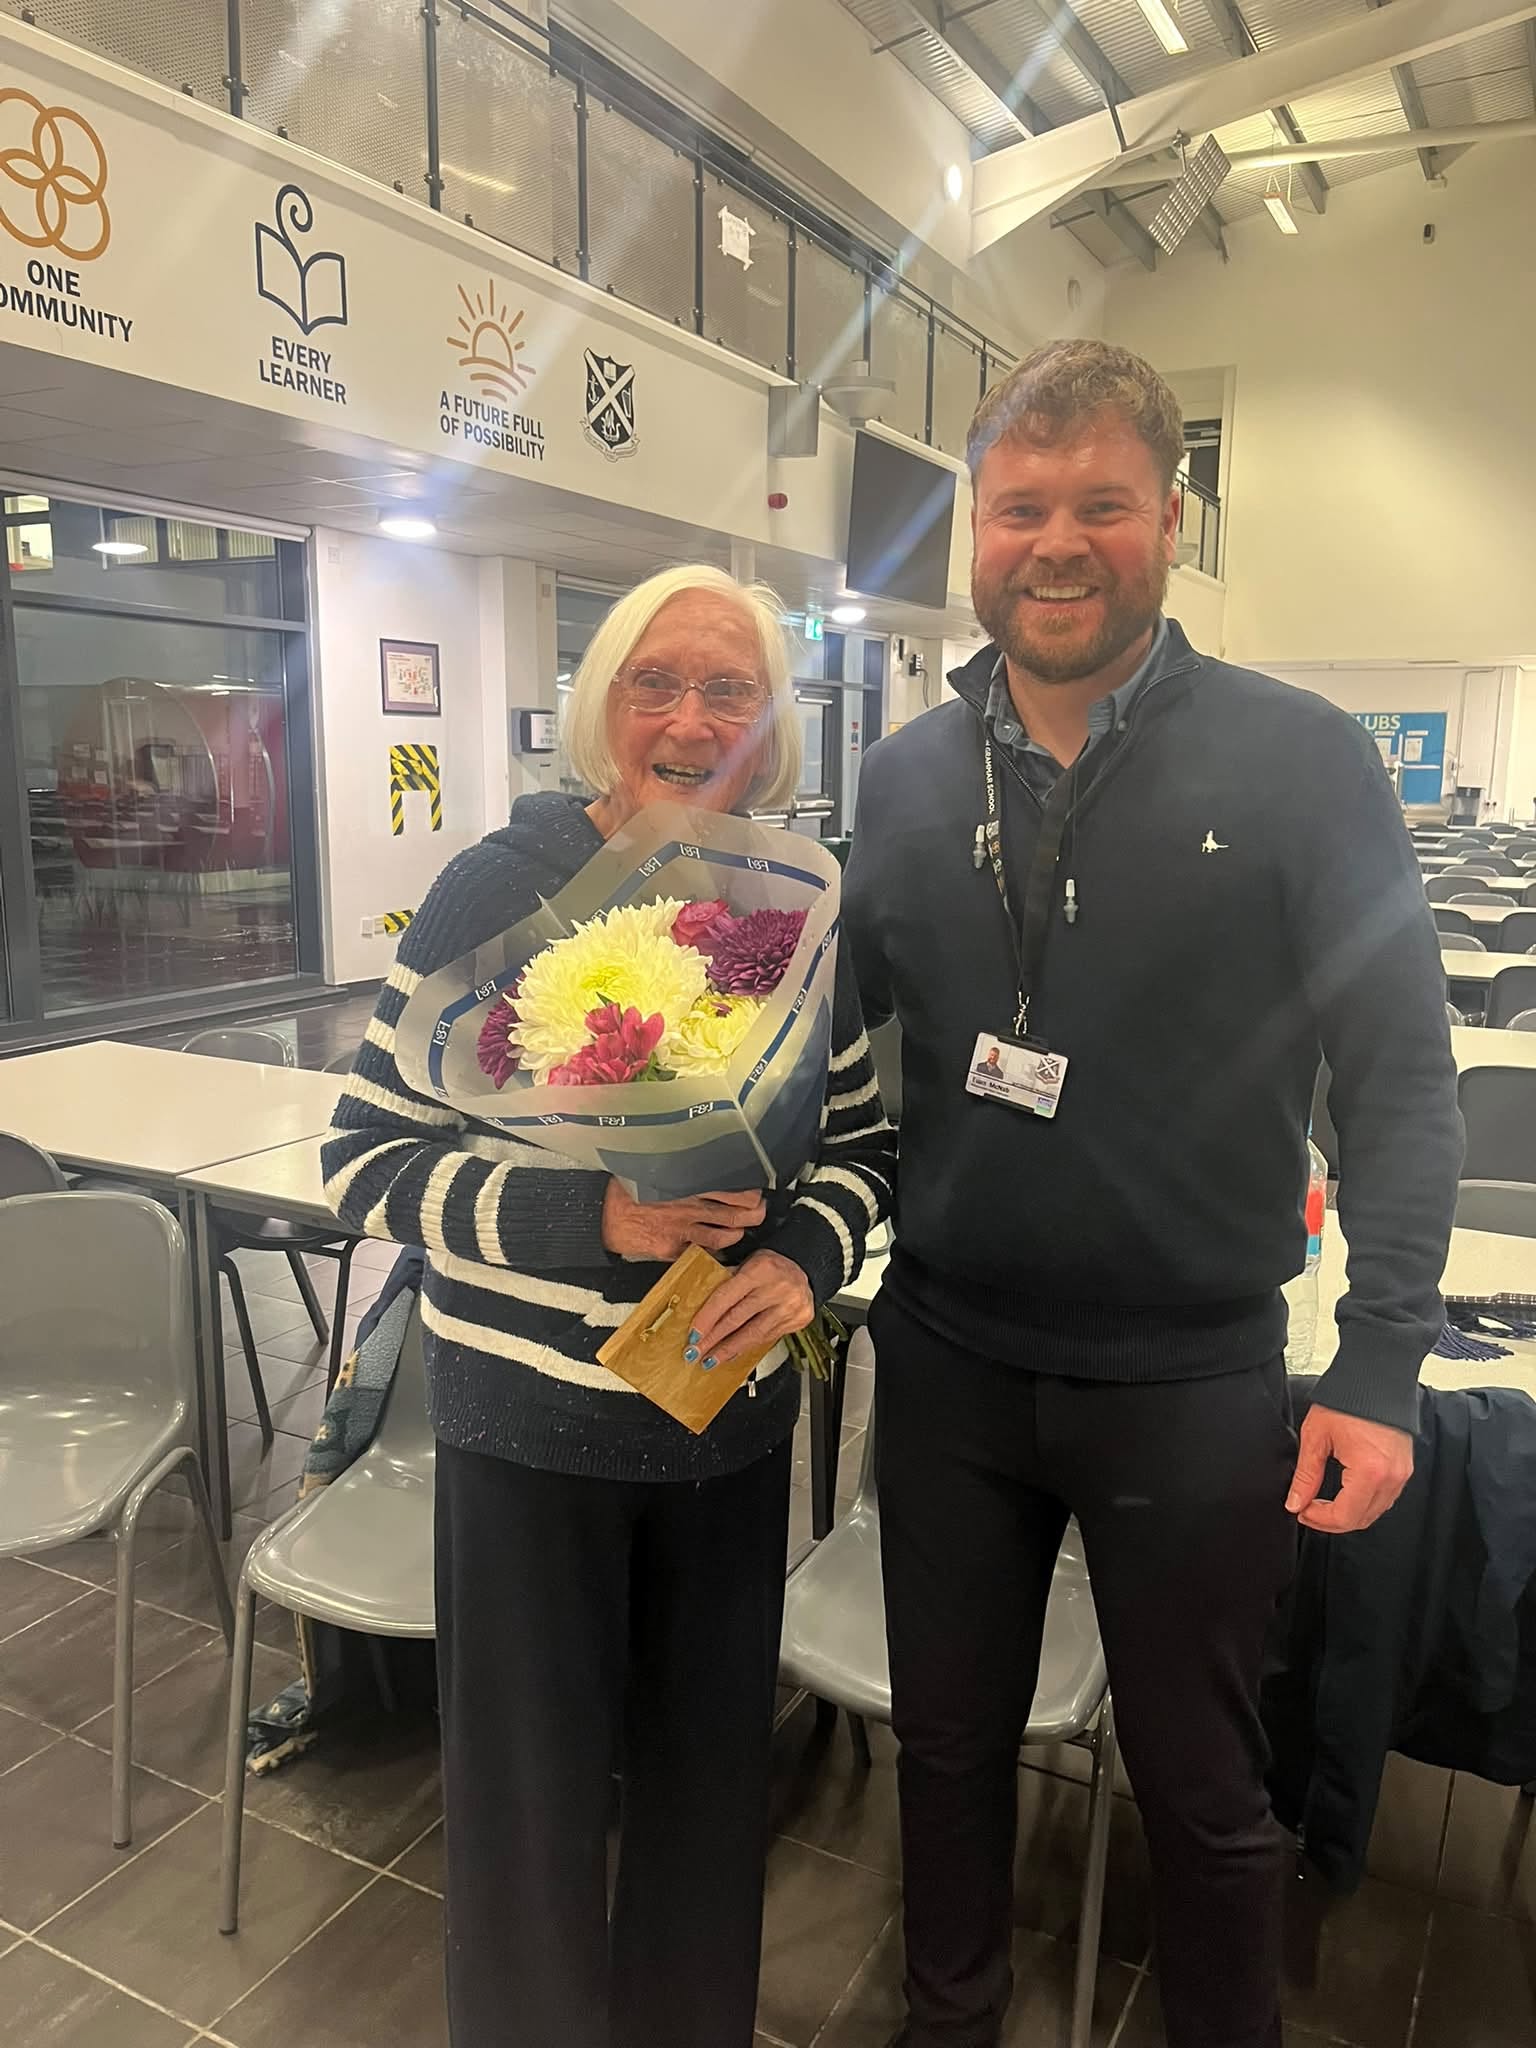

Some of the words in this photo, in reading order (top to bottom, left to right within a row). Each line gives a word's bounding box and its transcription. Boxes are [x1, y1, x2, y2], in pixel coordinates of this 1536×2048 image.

[27, 260, 80, 297] ONE
[272, 336, 331, 373] EVERY
[259, 359, 347, 405] LEARNER
[440, 390, 450, 410] A
[454, 395, 509, 429] FUTURE
[513, 414, 544, 440] FULL
[440, 414, 459, 436] OF
[464, 421, 545, 461] POSSIBILITY
[985, 747, 993, 783] GRAMMAR
[987, 784, 995, 815] SCHOOL
[599, 1116, 626, 1126] F&J
[689, 1102, 714, 1118] F&J
